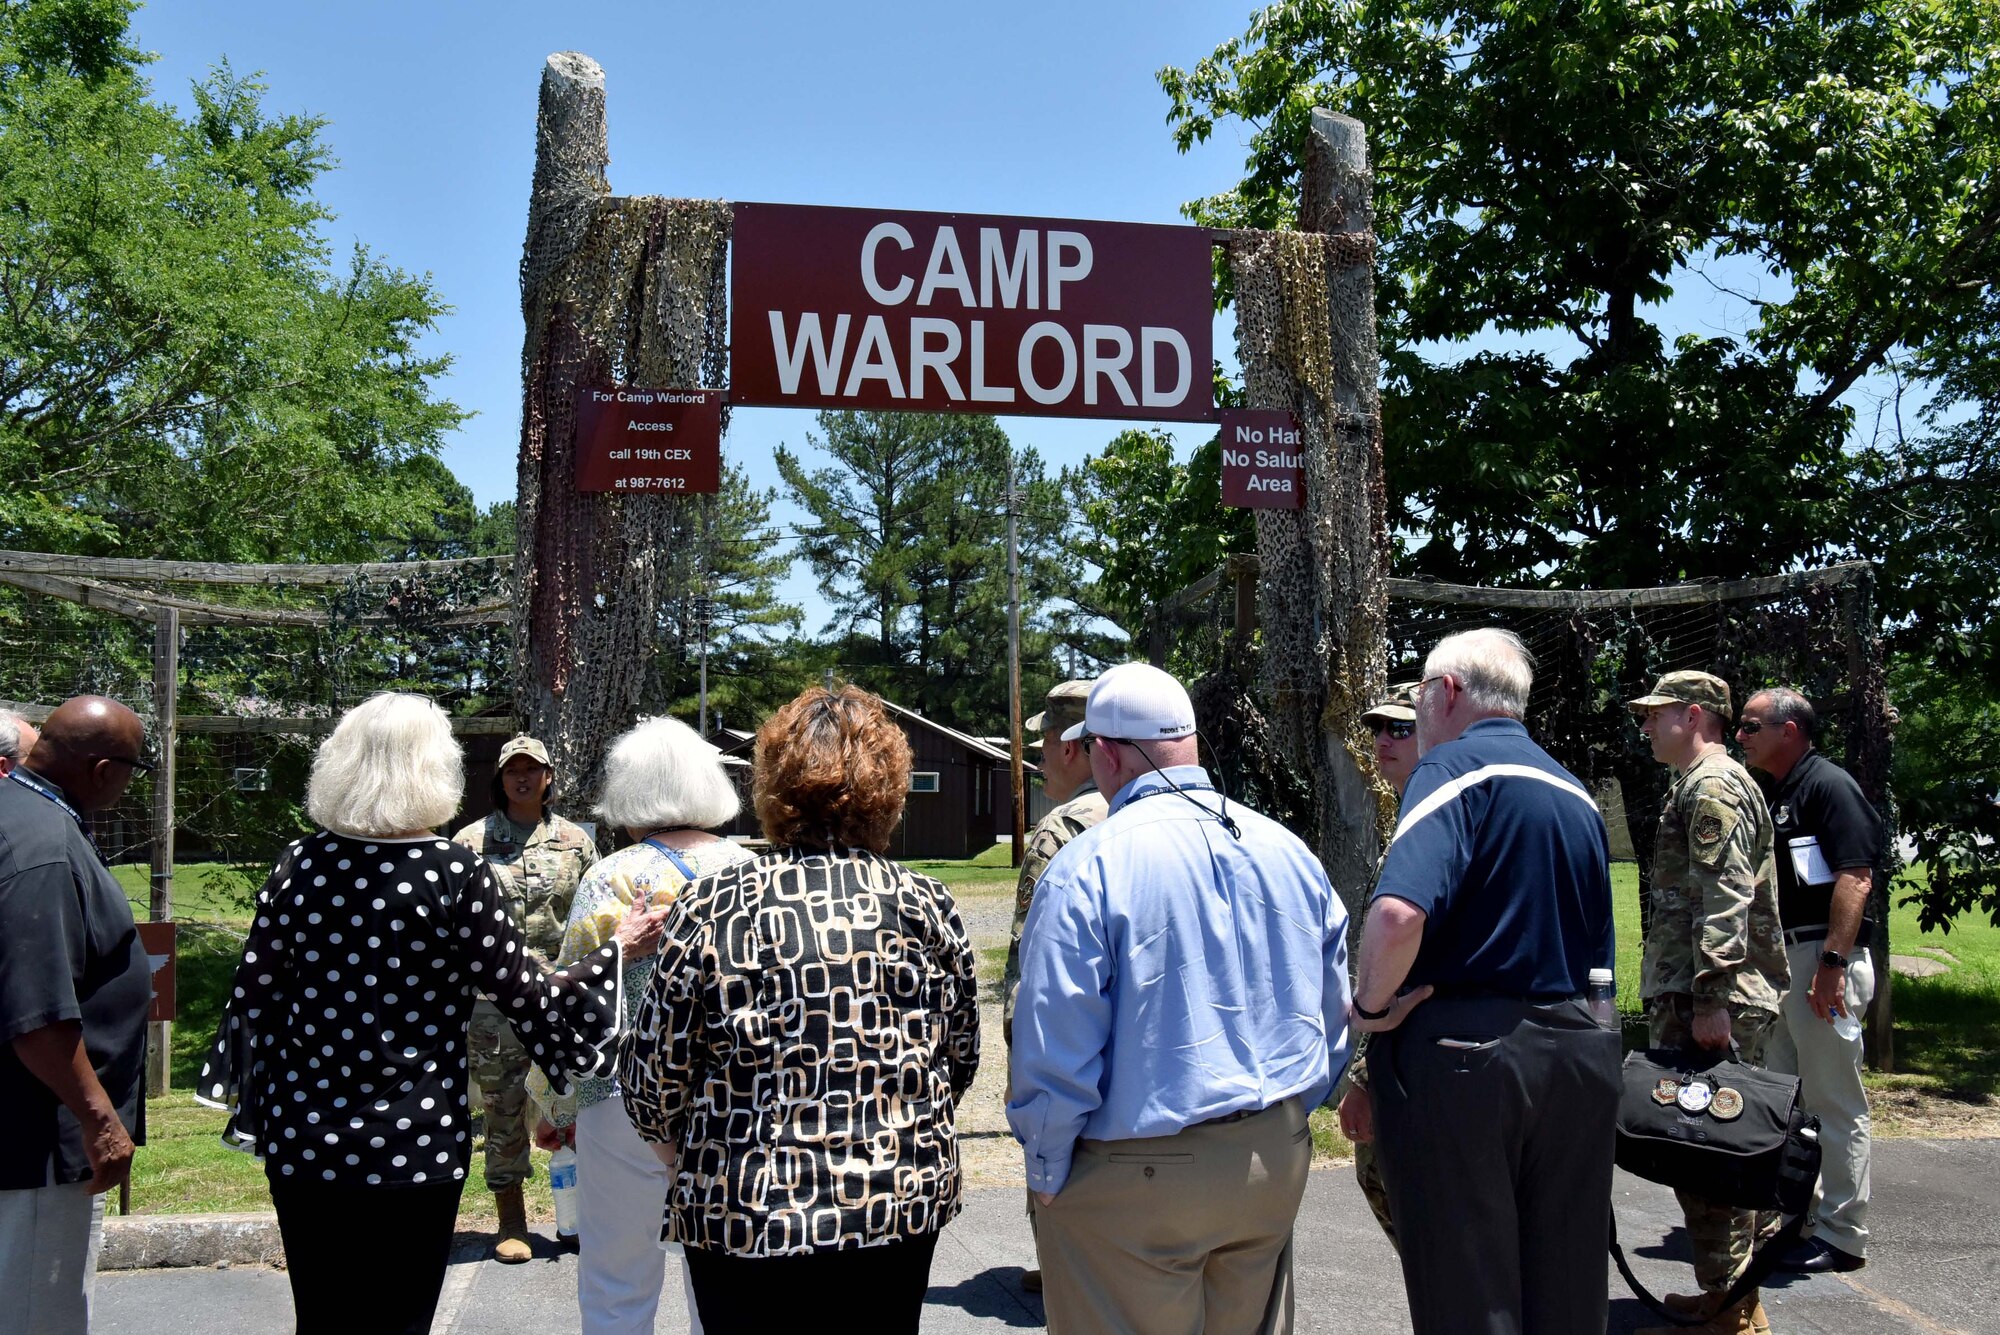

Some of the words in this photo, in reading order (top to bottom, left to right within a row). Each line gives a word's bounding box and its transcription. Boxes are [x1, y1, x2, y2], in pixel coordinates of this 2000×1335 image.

[860, 222, 1094, 310] CAMP
[768, 310, 1193, 408] WARLORD
[592, 391, 614, 402] For
[617, 392, 654, 405] Camp
[656, 393, 705, 404] Warlord
[627, 420, 673, 431] Access
[1236, 426, 1264, 443] No
[1269, 427, 1301, 445] Hat
[609, 449, 631, 459] call
[634, 449, 661, 460] 19th
[664, 449, 692, 460] CEX
[1222, 449, 1250, 467] No
[615, 478, 627, 488] at
[629, 477, 685, 489] 987-7612
[1246, 474, 1292, 492] Area
